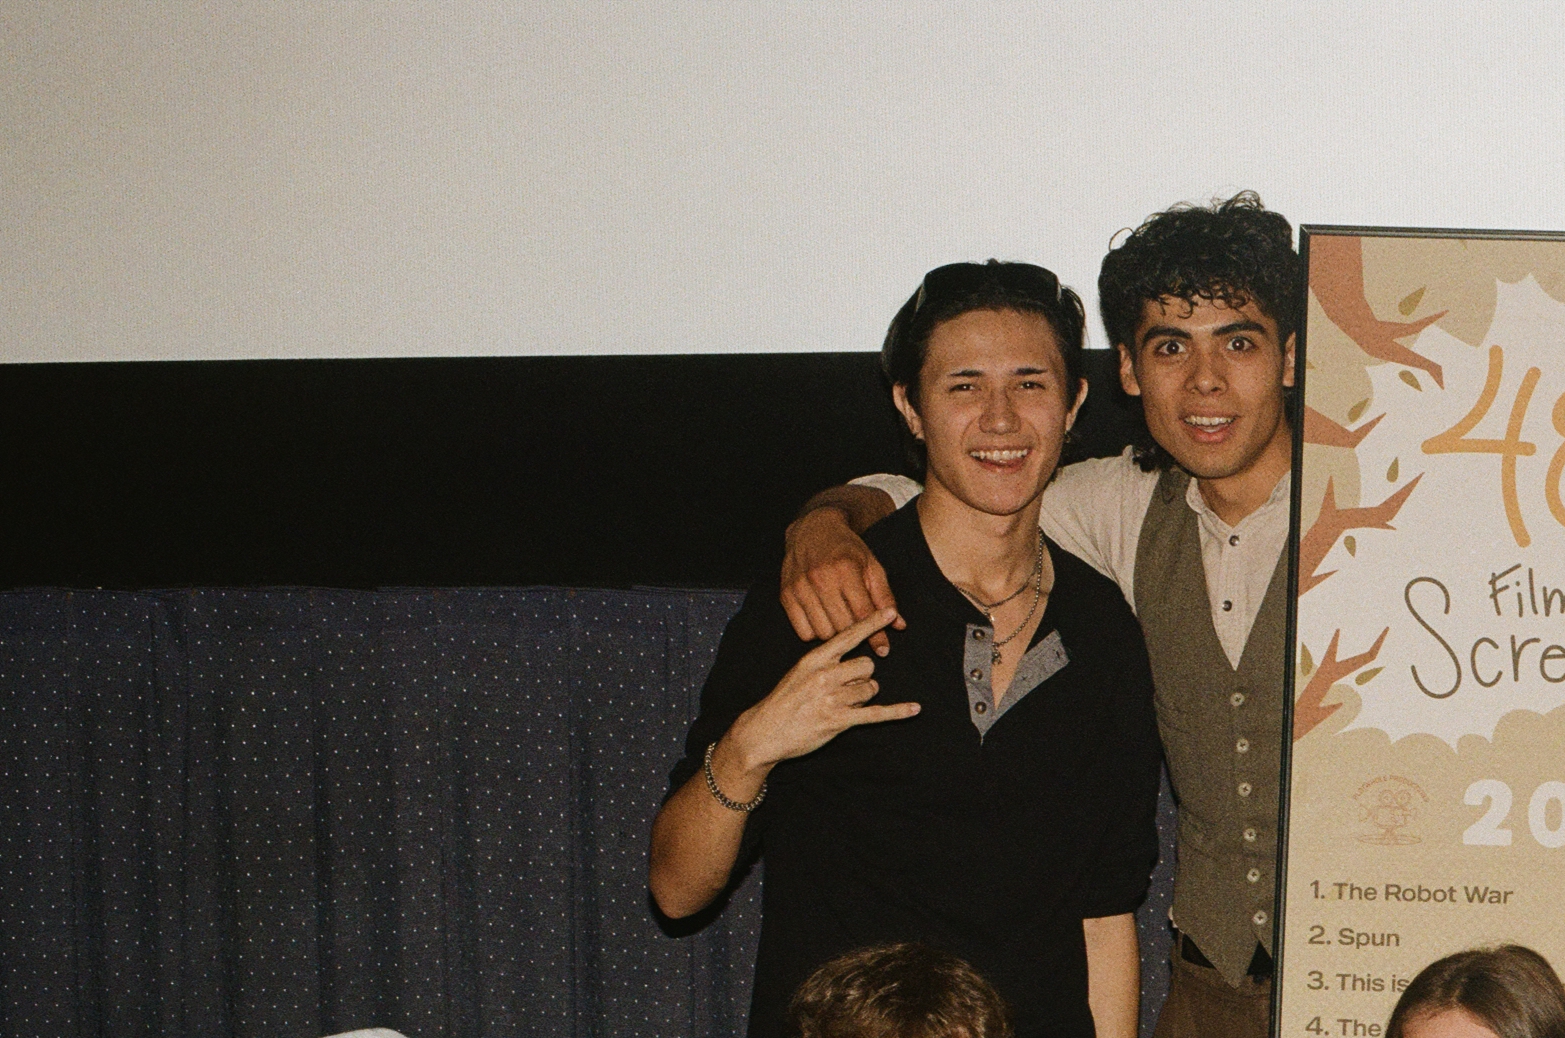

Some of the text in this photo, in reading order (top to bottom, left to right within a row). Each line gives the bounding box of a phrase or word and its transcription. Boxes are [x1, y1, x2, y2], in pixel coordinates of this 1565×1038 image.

[1310, 880, 1514, 904] 1. The Robot War
[1308, 925, 1400, 949] 2. Spun
[1307, 970, 1410, 992] 3. This is
[1305, 1016, 1382, 1037] 4. The
